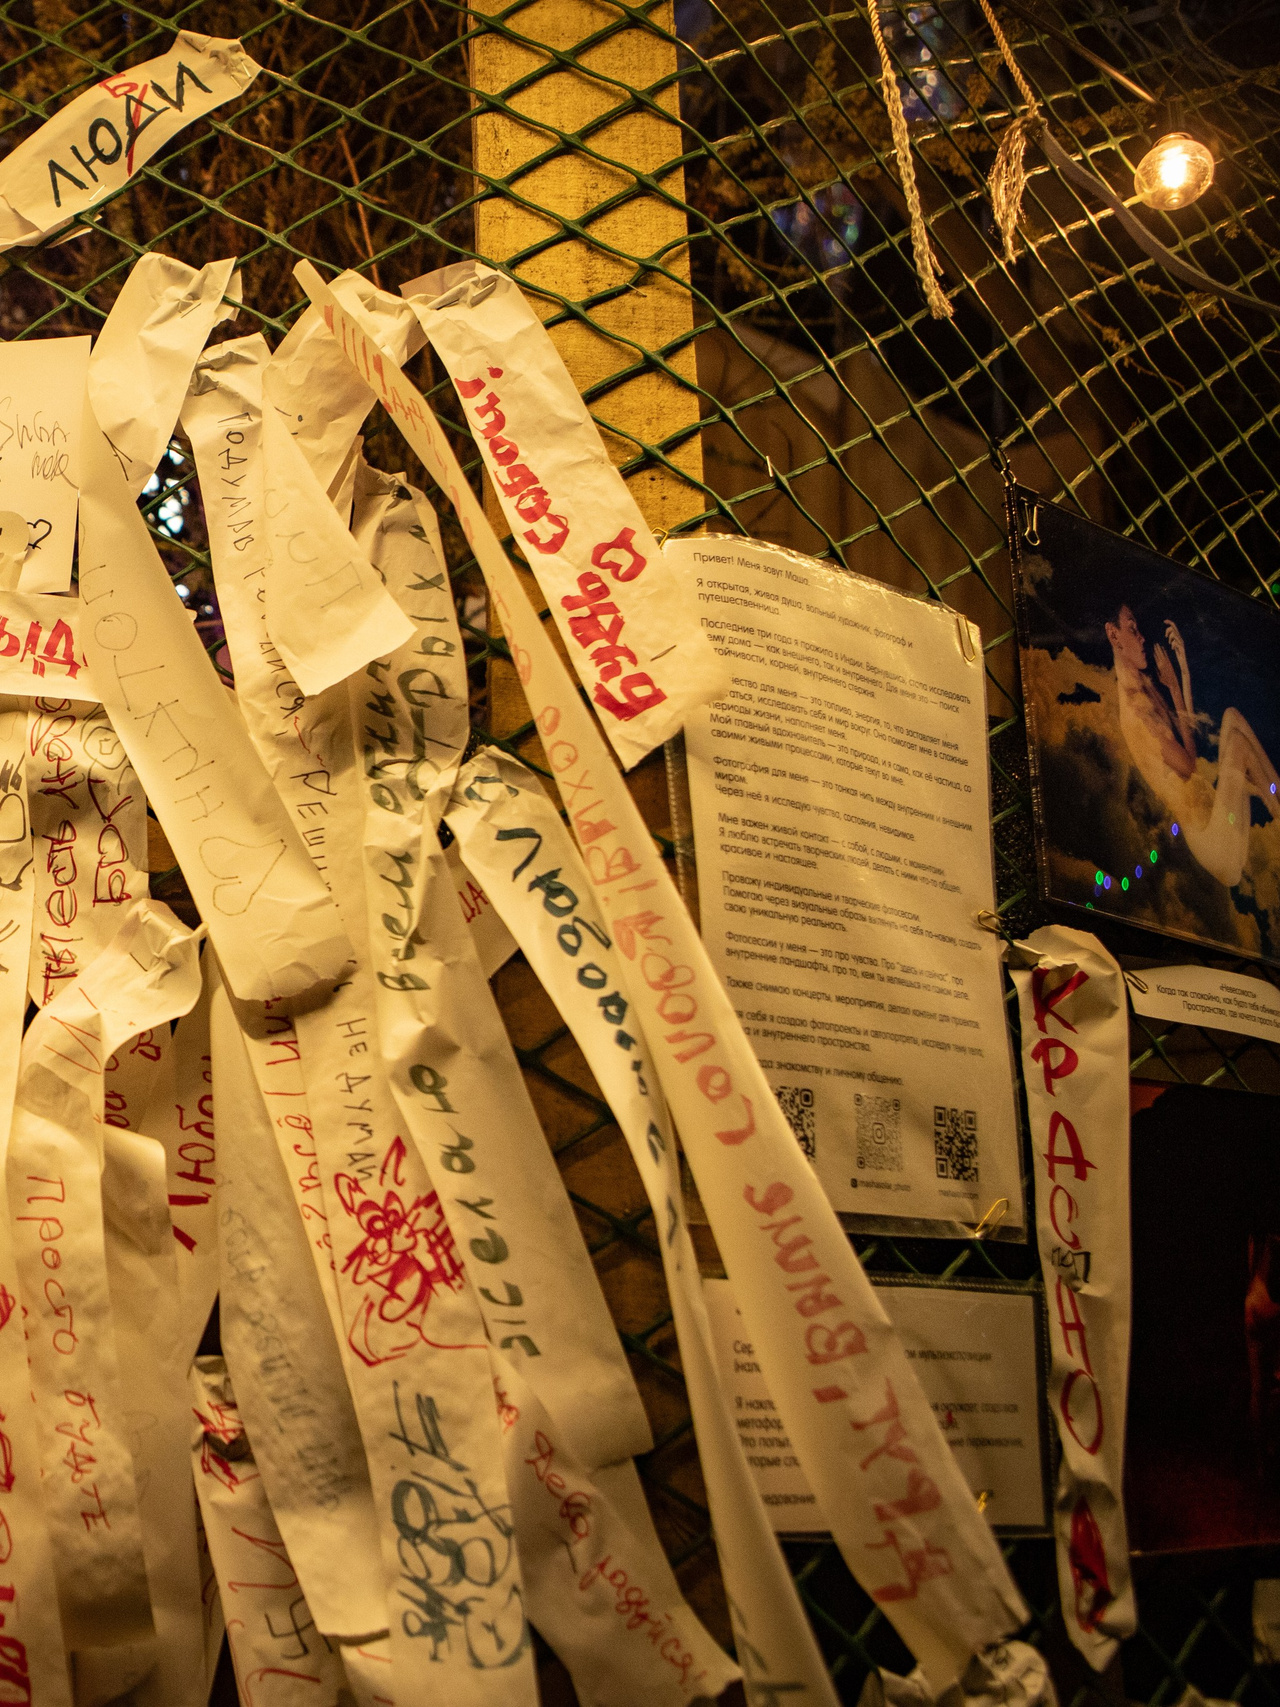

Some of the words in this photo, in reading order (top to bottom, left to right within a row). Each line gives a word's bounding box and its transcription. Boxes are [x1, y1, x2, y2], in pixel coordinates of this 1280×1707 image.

[48, 62, 211, 207] ЛЮДИ
[693, 552, 734, 564] Привет!
[737, 557, 760, 570] Меня
[763, 565, 783, 578] зовут
[785, 571, 810, 586] Маша.
[698, 592, 781, 615] путешественница.
[707, 580, 752, 595] открытая,
[754, 588, 779, 601] живая
[782, 596, 804, 610] душа,
[562, 572, 667, 724] Будь
[728, 636, 751, 648] дома
[766, 644, 780, 654] как
[701, 617, 754, 635] Последние
[757, 626, 772, 639] три
[774, 632, 791, 644] года
[929, 685, 970, 704] исследовать
[770, 658, 801, 674] корней,
[803, 668, 846, 688] внутреннего
[758, 696, 808, 715] исследовать
[810, 710, 826, 720] себя
[710, 713, 731, 725] Мой
[734, 718, 770, 733] главный
[772, 728, 825, 747] вдохновитель
[753, 710, 783, 723] жизни,
[828, 728, 847, 740] меня.
[711, 729, 746, 741] своими
[748, 736, 783, 749] живыми
[713, 756, 769, 775] Фотография
[789, 773, 809, 783] меня
[715, 772, 748, 784] миром.
[715, 784, 744, 798] Через
[772, 796, 811, 813] исследую
[718, 812, 738, 825] Мне
[741, 818, 768, 830] важен
[771, 824, 798, 837] живой
[728, 830, 758, 843] люблю
[762, 837, 801, 851] встречать
[721, 844, 762, 858] красивое
[773, 853, 818, 869] настоящее.
[723, 886, 763, 901] Помогаю
[765, 895, 790, 907] через
[764, 881, 832, 901] индивидуальные
[725, 931, 777, 948] Фотосессии
[786, 942, 807, 953] меня
[336, 1016, 369, 1060] НЕ
